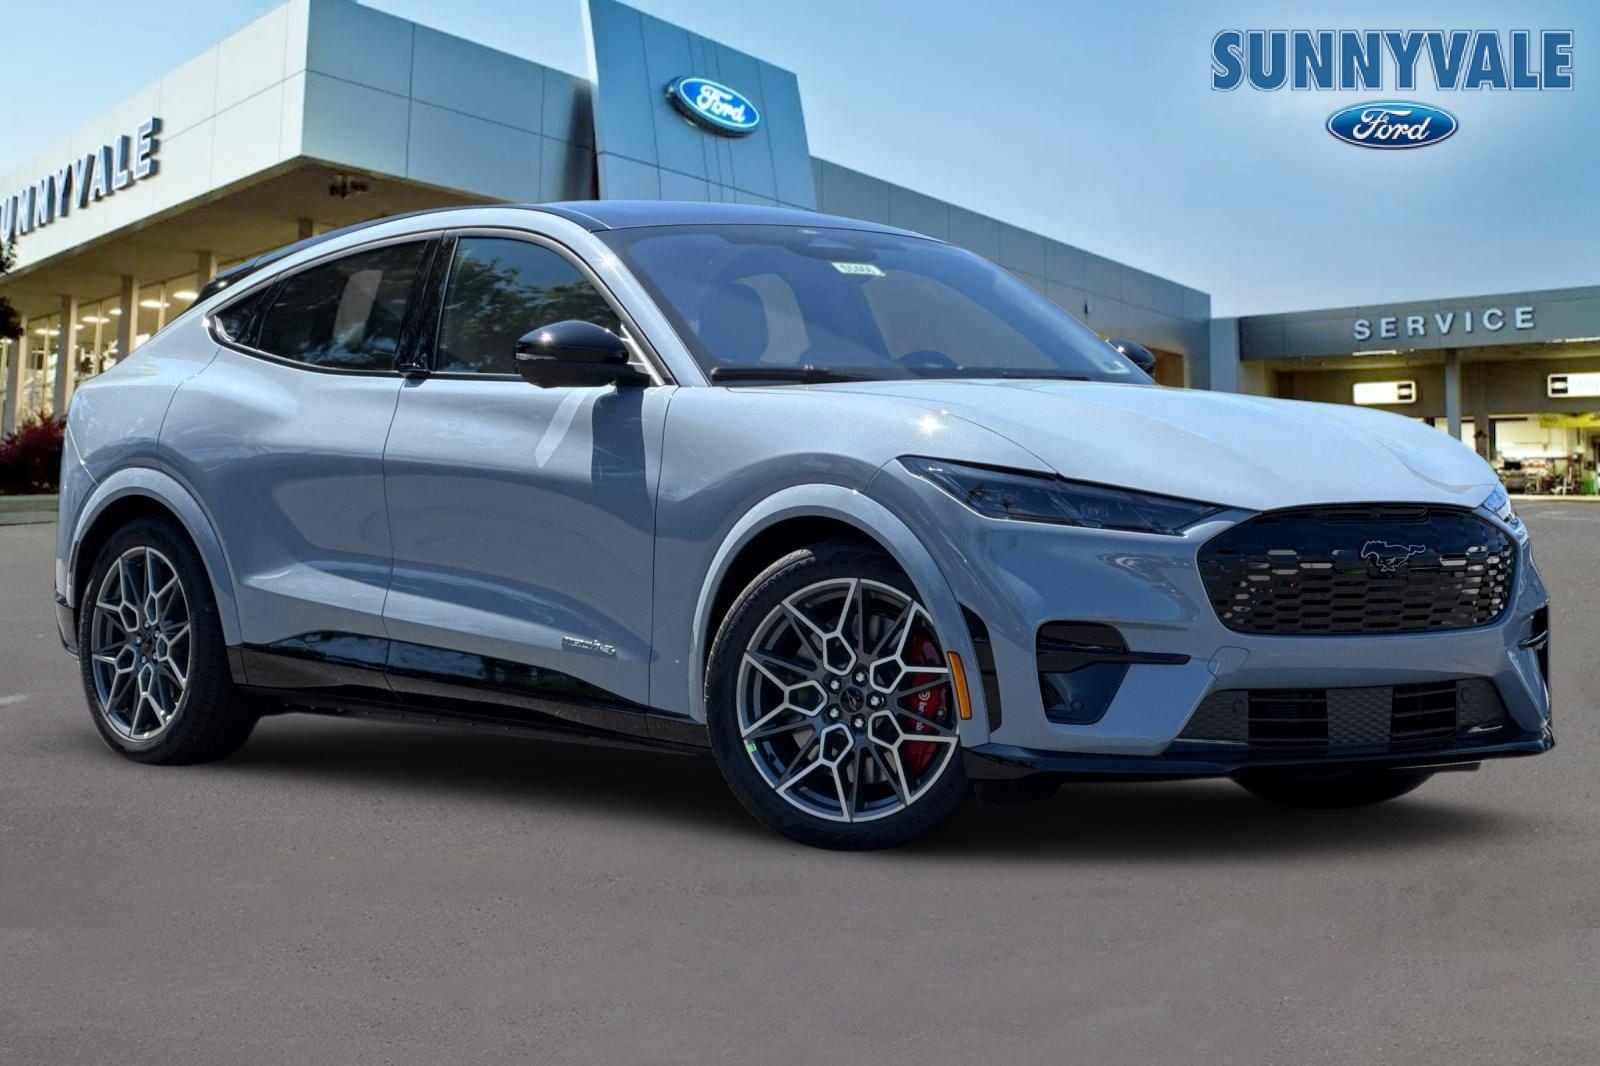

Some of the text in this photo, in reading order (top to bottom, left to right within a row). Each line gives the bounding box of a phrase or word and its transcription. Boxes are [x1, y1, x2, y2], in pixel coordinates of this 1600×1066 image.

[696, 84, 746, 123] Ford
[0, 117, 162, 241] UNNYVALE
[1353, 306, 1536, 340] SERVICE
